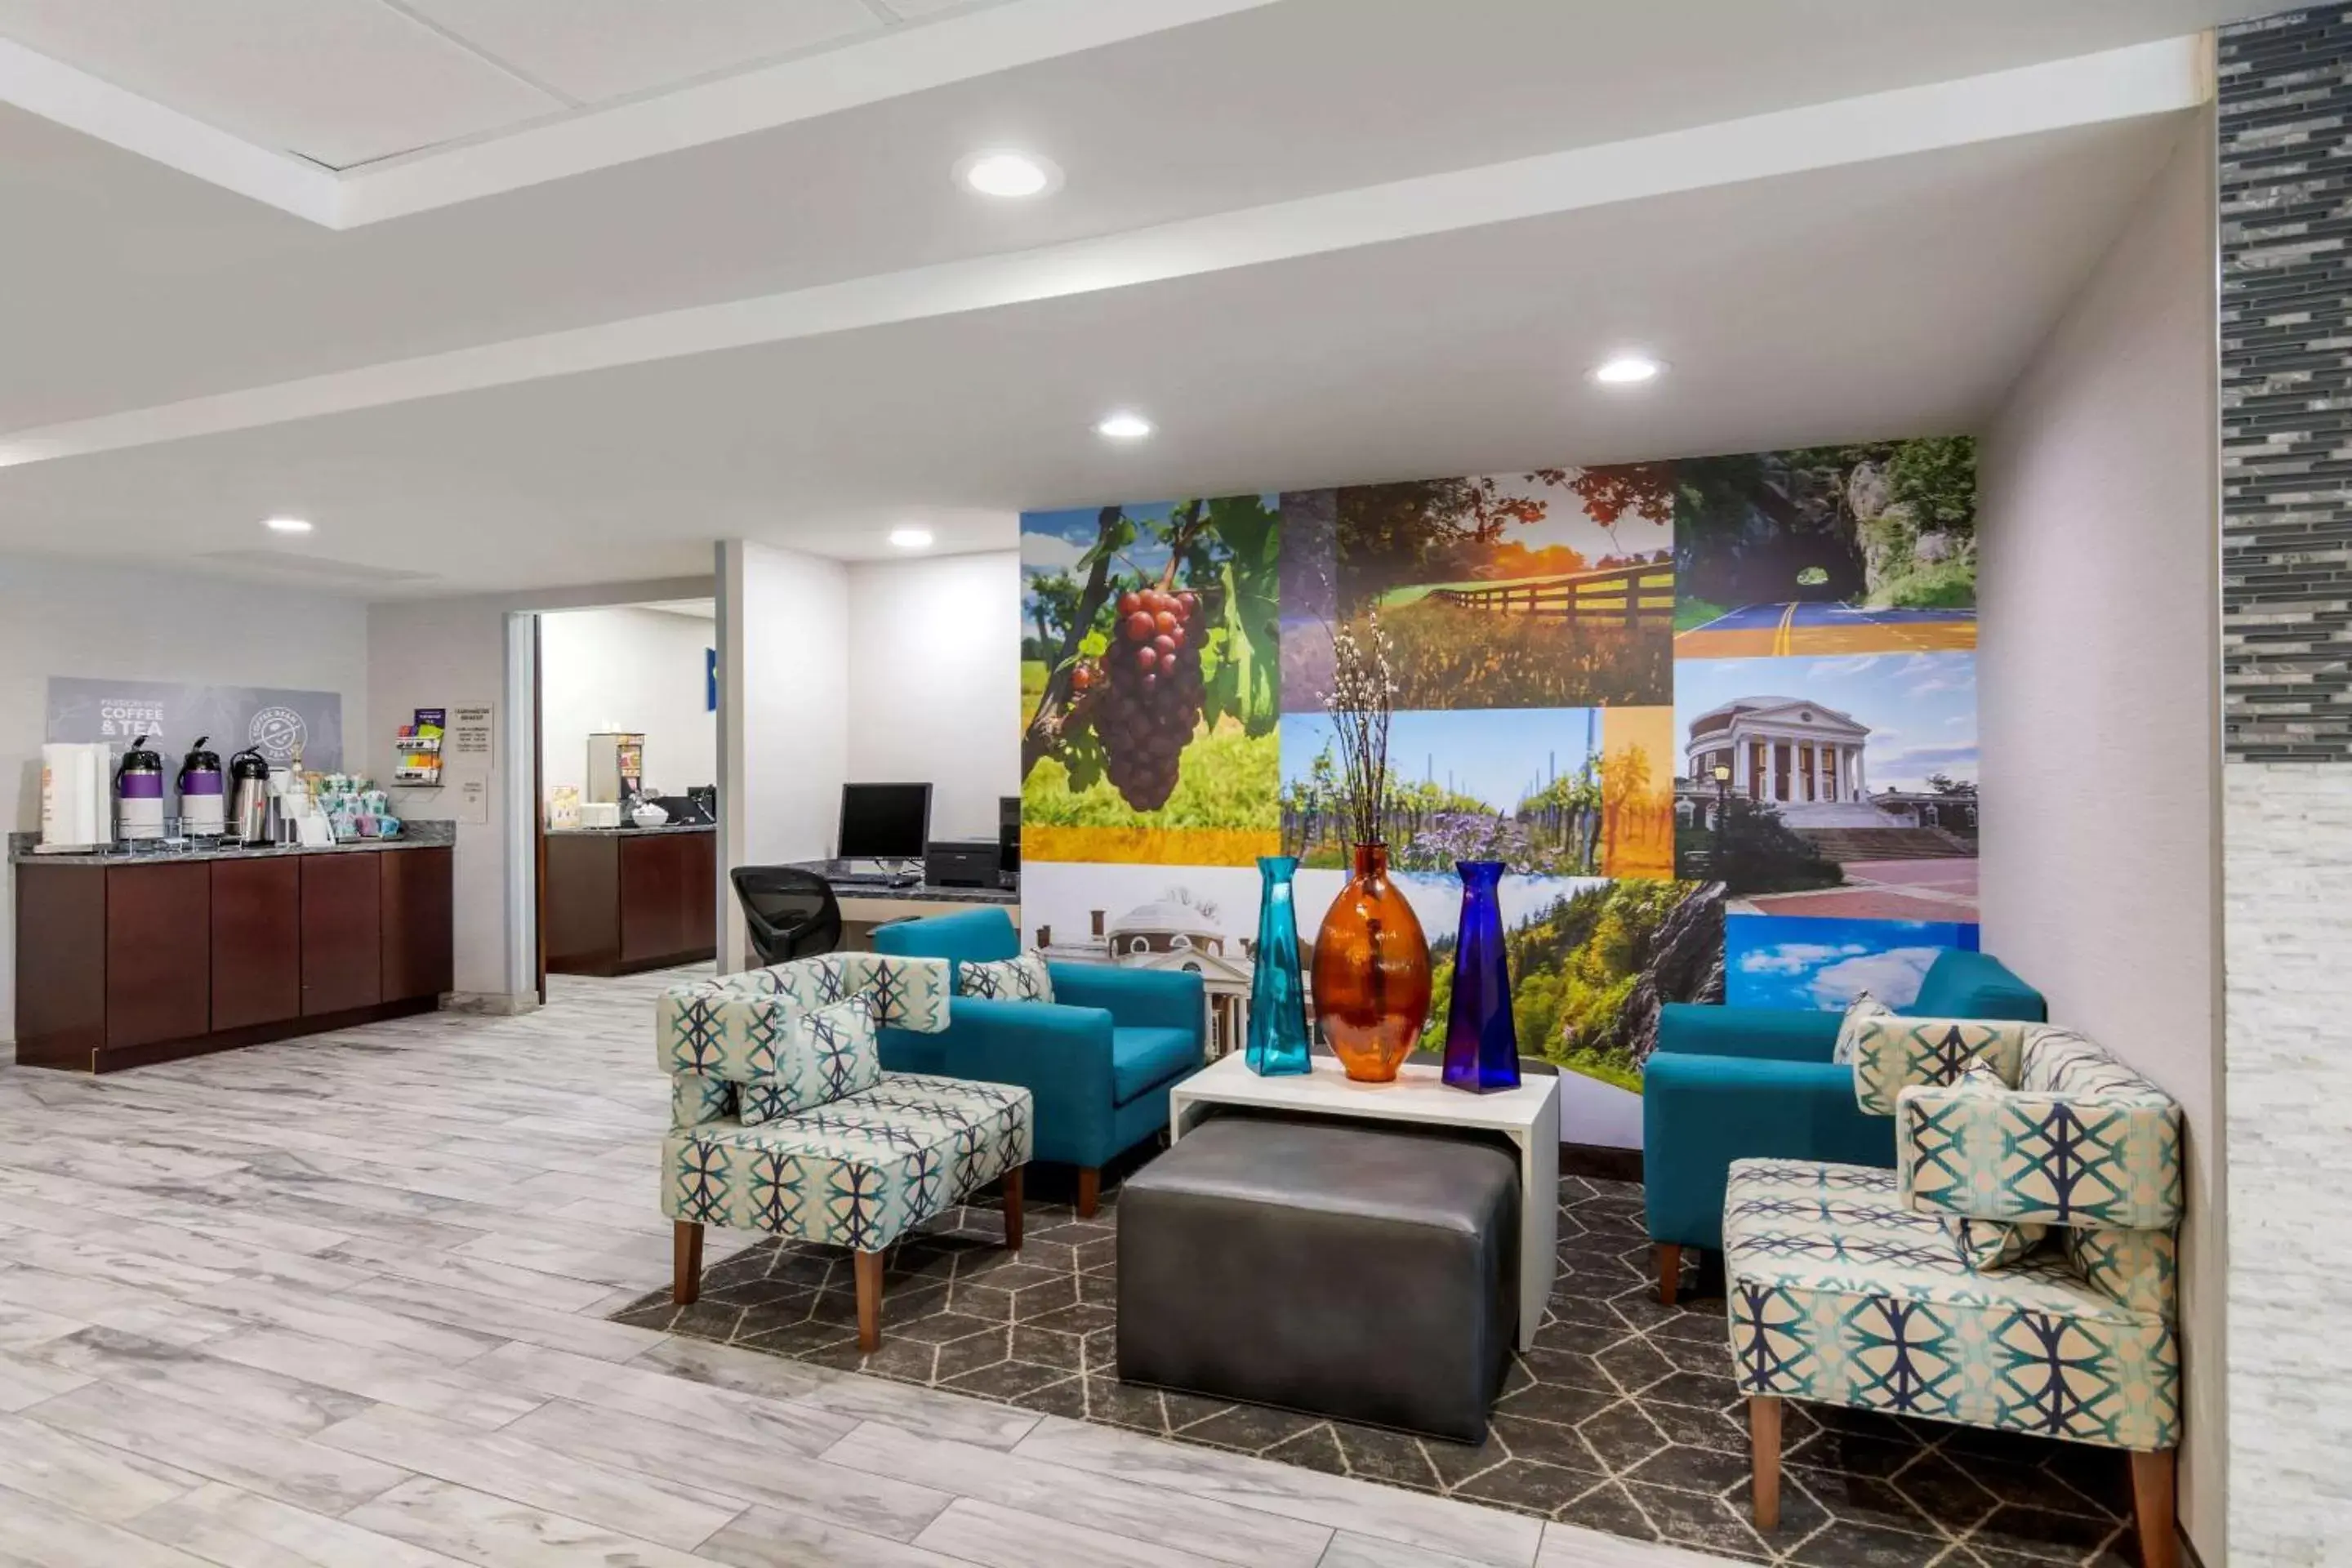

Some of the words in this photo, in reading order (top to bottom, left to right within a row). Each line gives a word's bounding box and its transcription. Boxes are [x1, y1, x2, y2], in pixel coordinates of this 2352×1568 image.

[101, 707, 164, 719] COFFEE
[100, 719, 116, 735] &
[118, 720, 163, 737] TEA
